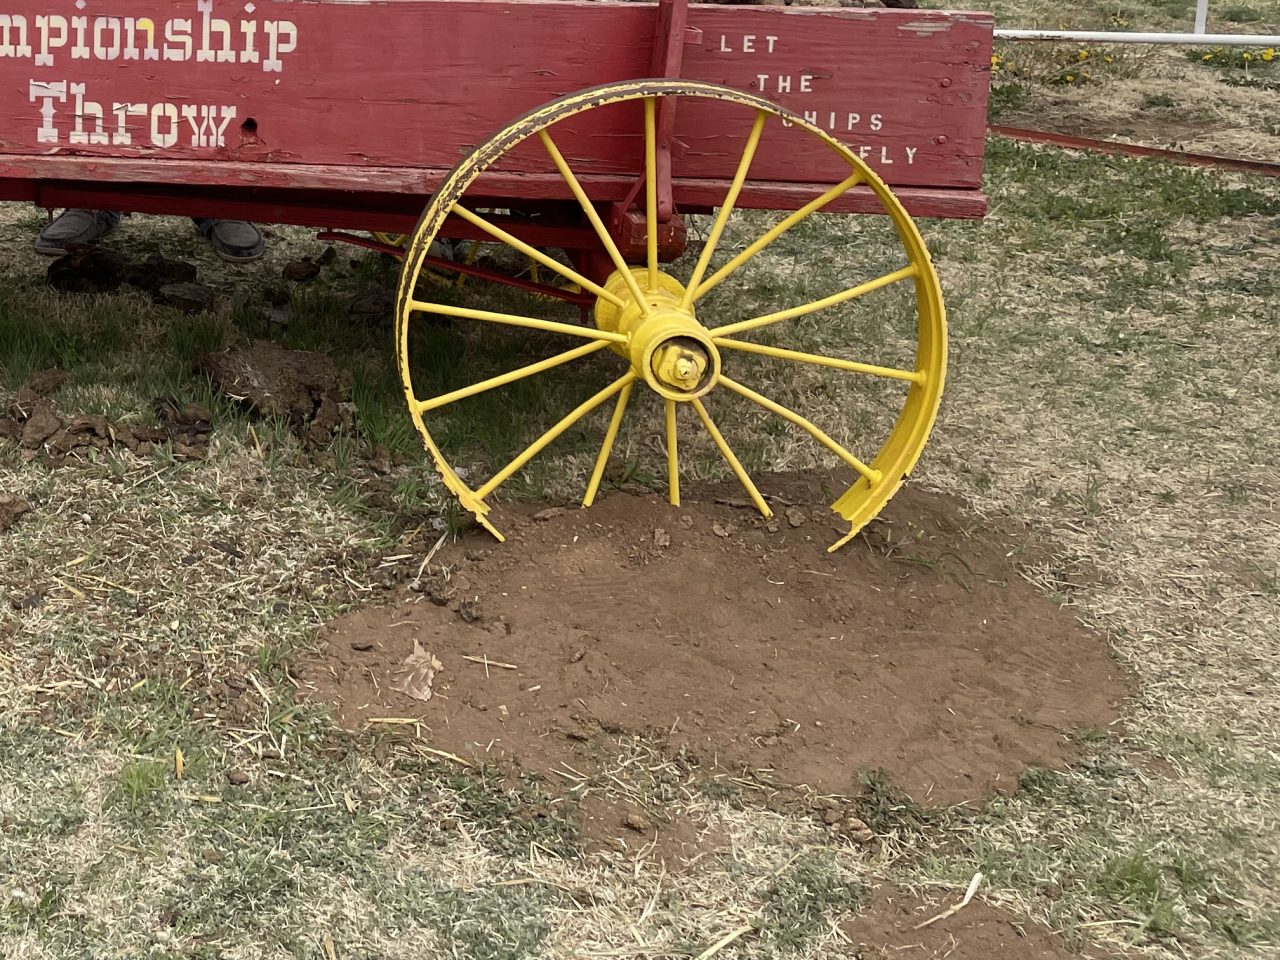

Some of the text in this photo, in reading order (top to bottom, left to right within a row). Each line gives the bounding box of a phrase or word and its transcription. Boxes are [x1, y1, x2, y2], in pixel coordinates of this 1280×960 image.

[720, 35, 778, 53] LET
[756, 74, 813, 93] THE
[29, 79, 238, 148] Throw
[860, 146, 917, 165] FLY
